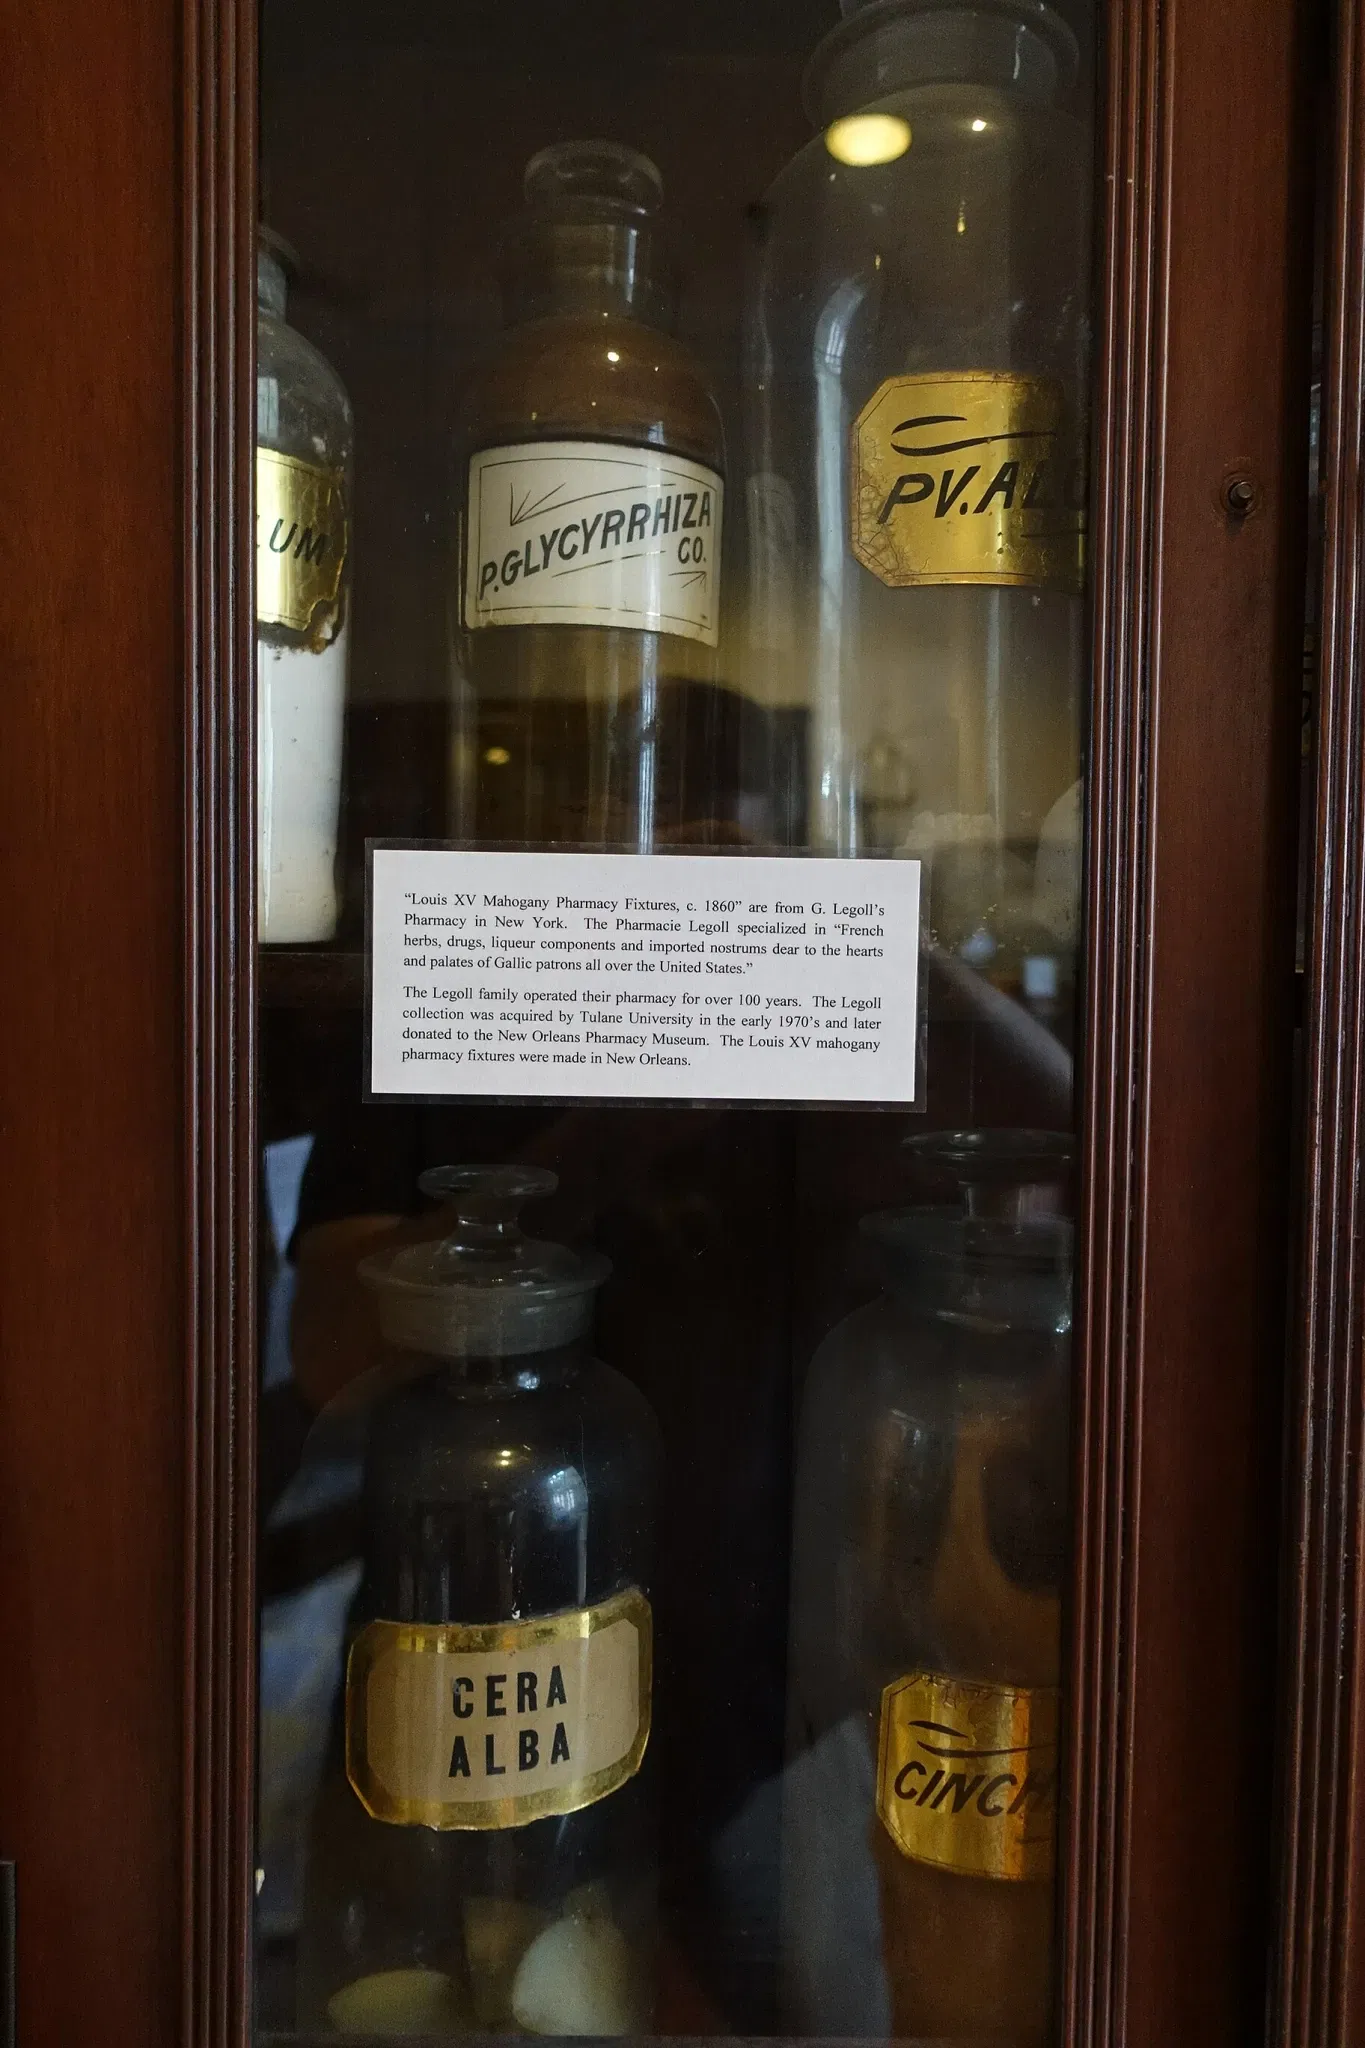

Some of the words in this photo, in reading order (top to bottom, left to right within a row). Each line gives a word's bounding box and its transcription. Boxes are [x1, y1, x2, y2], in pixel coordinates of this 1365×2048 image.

[257, 515, 327, 566] UM
[677, 536, 707, 565] CO.
[454, 893, 476, 906] XV
[483, 894, 549, 911] Mahogany
[556, 896, 618, 913] Pharmacy
[624, 897, 680, 913] Fixtures,
[686, 902, 696, 911] c.
[748, 903, 768, 913] are
[775, 901, 804, 914] from
[811, 902, 826, 914] G.
[404, 913, 466, 929] Pharmacy
[475, 914, 486, 927] in
[494, 915, 524, 928] New
[532, 916, 567, 929] York.
[583, 917, 608, 929] The
[615, 918, 681, 931] Pharmacie
[689, 919, 729, 936] Legoll
[737, 921, 806, 937] specialized
[814, 922, 826, 935] in
[404, 933, 441, 948] herbs,
[446, 935, 485, 951] drugs,
[491, 935, 536, 952] liqueur
[540, 939, 616, 953] components
[620, 939, 643, 951] and
[649, 939, 705, 955] imported
[710, 943, 767, 954] nostrums
[772, 942, 799, 955] dear
[804, 945, 816, 955] to
[821, 943, 840, 956] the
[846, 944, 883, 957] hearts
[403, 954, 426, 966] and
[430, 955, 474, 970] palates
[476, 955, 493, 968] of
[494, 955, 532, 969] Gallic
[535, 959, 582, 973] patrons
[585, 958, 601, 970] all
[604, 962, 633, 971] over
[636, 959, 655, 972] the
[659, 960, 701, 973] United
[402, 985, 427, 998] The
[432, 986, 472, 1002] Legoll
[478, 987, 518, 1003] family
[523, 988, 577, 1004] operated
[582, 989, 611, 1002] their
[615, 990, 676, 1007] pharmacy
[682, 992, 700, 1004] for
[704, 996, 733, 1005] over
[739, 994, 761, 1006] 100
[765, 997, 801, 1010] years.
[811, 995, 836, 1008] The
[841, 996, 881, 1011] Legoll
[402, 1006, 464, 1019] collection
[469, 1011, 494, 1020] was
[499, 1008, 553, 1025] acquired
[558, 1010, 574, 1025] by
[579, 1010, 623, 1023] Tulane
[628, 1011, 693, 1028] University
[699, 1013, 711, 1025] in
[716, 1013, 736, 1026] the
[741, 1014, 772, 1030] early
[825, 1016, 848, 1028] and
[854, 1017, 881, 1029] later
[402, 1026, 452, 1040] donated
[456, 1030, 469, 1040] to
[474, 1028, 493, 1040] the
[497, 1029, 527, 1041] New
[532, 1029, 581, 1042] Orleans
[585, 1031, 647, 1047] Pharmacy
[652, 1032, 709, 1045] Museum.
[719, 1034, 743, 1046] The
[749, 1035, 784, 1047] Louis
[789, 1036, 811, 1048] XV
[815, 1036, 880, 1053] mahogany
[401, 1047, 463, 1063] pharmacy
[467, 1048, 515, 1062] fixtures
[519, 1053, 549, 1063] were
[552, 1051, 586, 1063] made
[590, 1051, 602, 1063] in
[606, 1052, 636, 1065] New
[639, 1052, 691, 1066] Orleans.
[451, 1665, 569, 1719] CERA
[448, 1722, 570, 1777] ALBA
